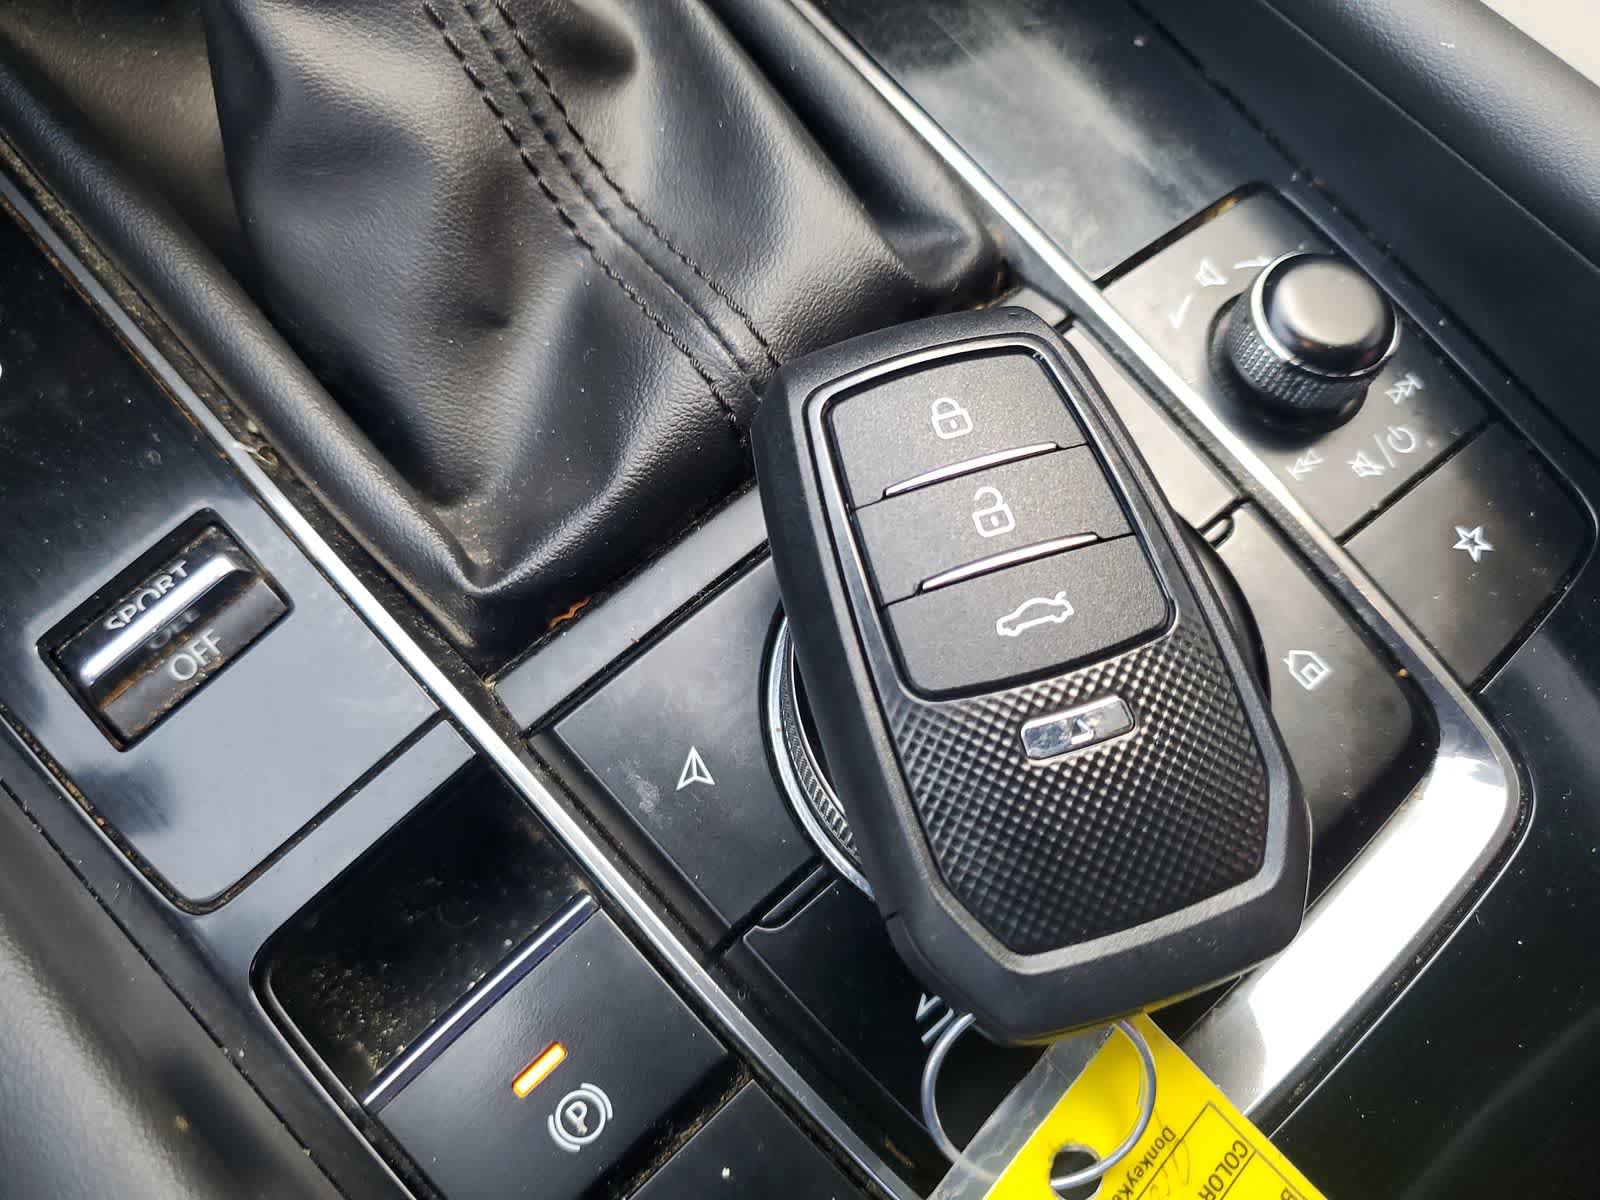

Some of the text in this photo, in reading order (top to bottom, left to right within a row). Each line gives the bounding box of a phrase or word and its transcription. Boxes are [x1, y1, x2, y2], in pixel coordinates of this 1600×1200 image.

[103, 560, 187, 630] SPORT
[170, 628, 221, 681] OFF
[1197, 1139, 1248, 1200] COLOR
